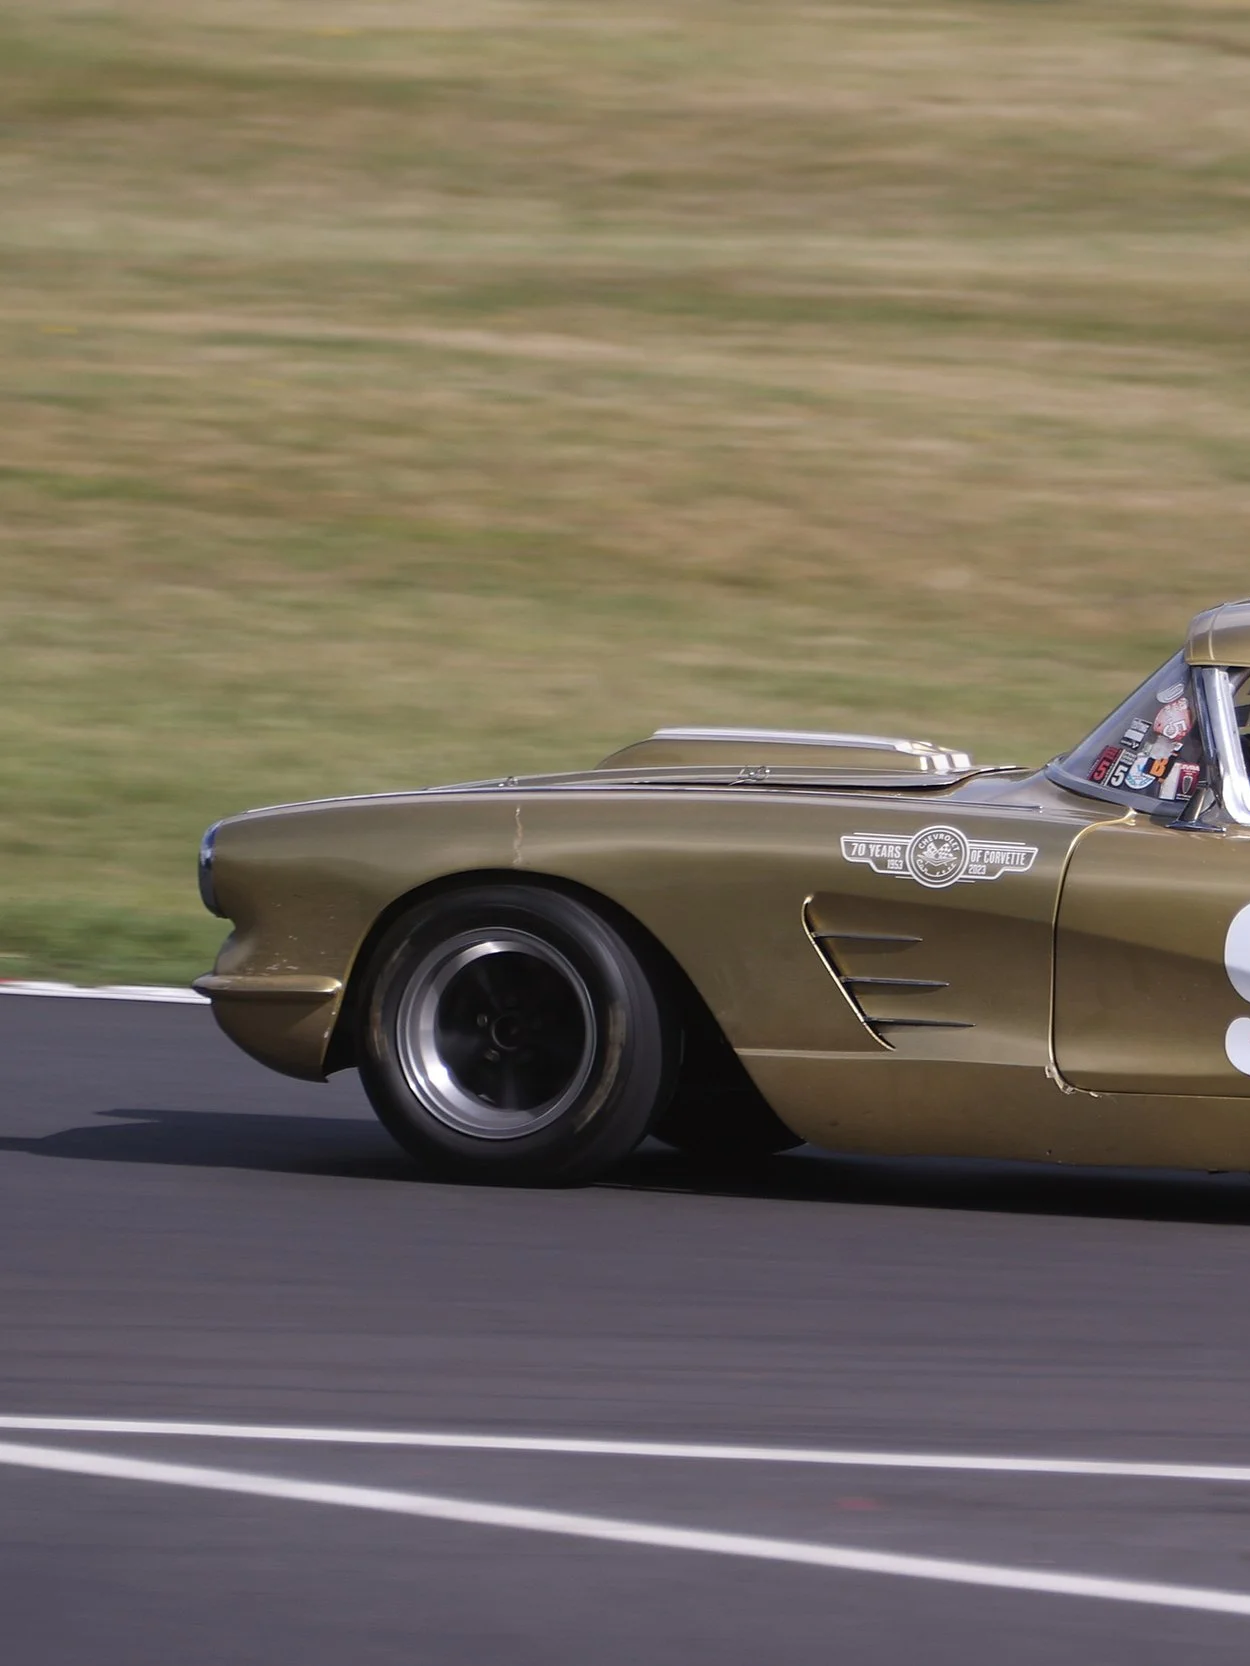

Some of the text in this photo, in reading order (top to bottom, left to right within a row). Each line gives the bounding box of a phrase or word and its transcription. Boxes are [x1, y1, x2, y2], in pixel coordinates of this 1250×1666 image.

[1110, 765, 1129, 787] 5
[918, 833, 960, 851] CHEVROLET
[851, 843, 901, 858] 70 YEARS
[971, 850, 1025, 865] OF CORVETTE
[887, 859, 903, 870] 1953
[968, 864, 987, 875] 2023
